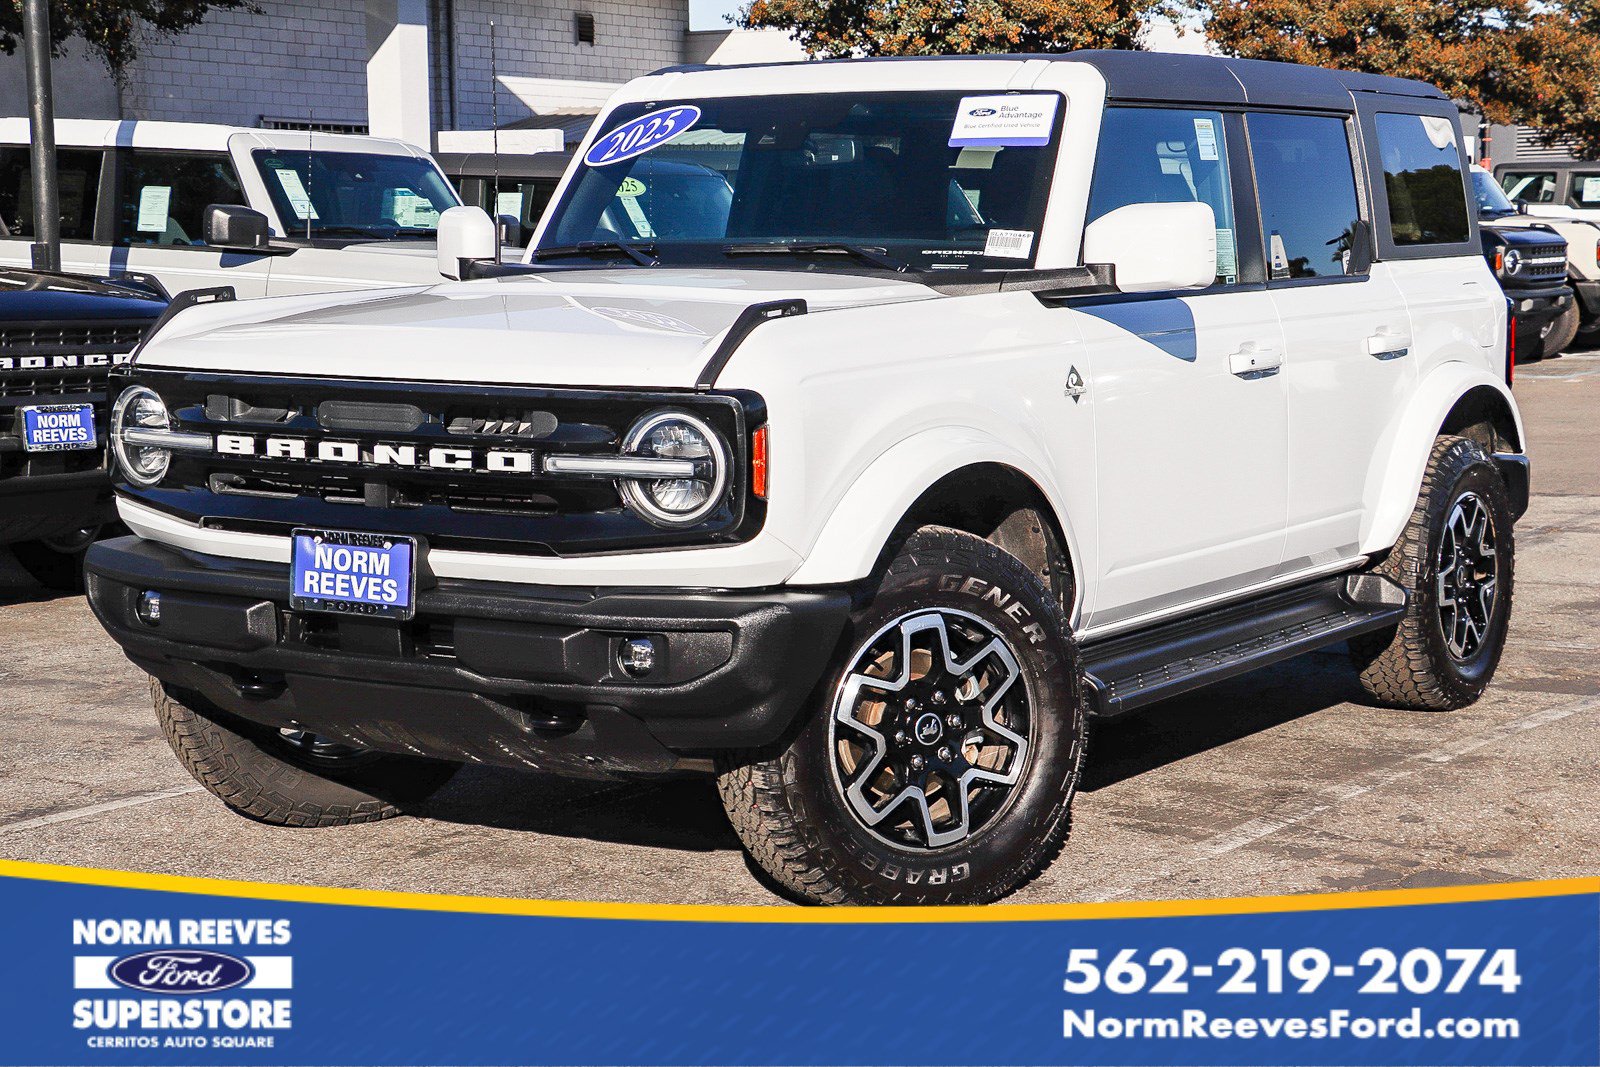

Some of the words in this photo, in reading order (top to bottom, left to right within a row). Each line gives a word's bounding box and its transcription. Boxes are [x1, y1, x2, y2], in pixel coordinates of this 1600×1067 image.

[599, 109, 684, 161] 2025
[33, 427, 88, 442] REEVES
[37, 413, 81, 429] NORM
[217, 434, 534, 474] BRONCO
[314, 547, 390, 576] NORM
[304, 570, 398, 602] REEVES
[325, 601, 379, 614] FORD
